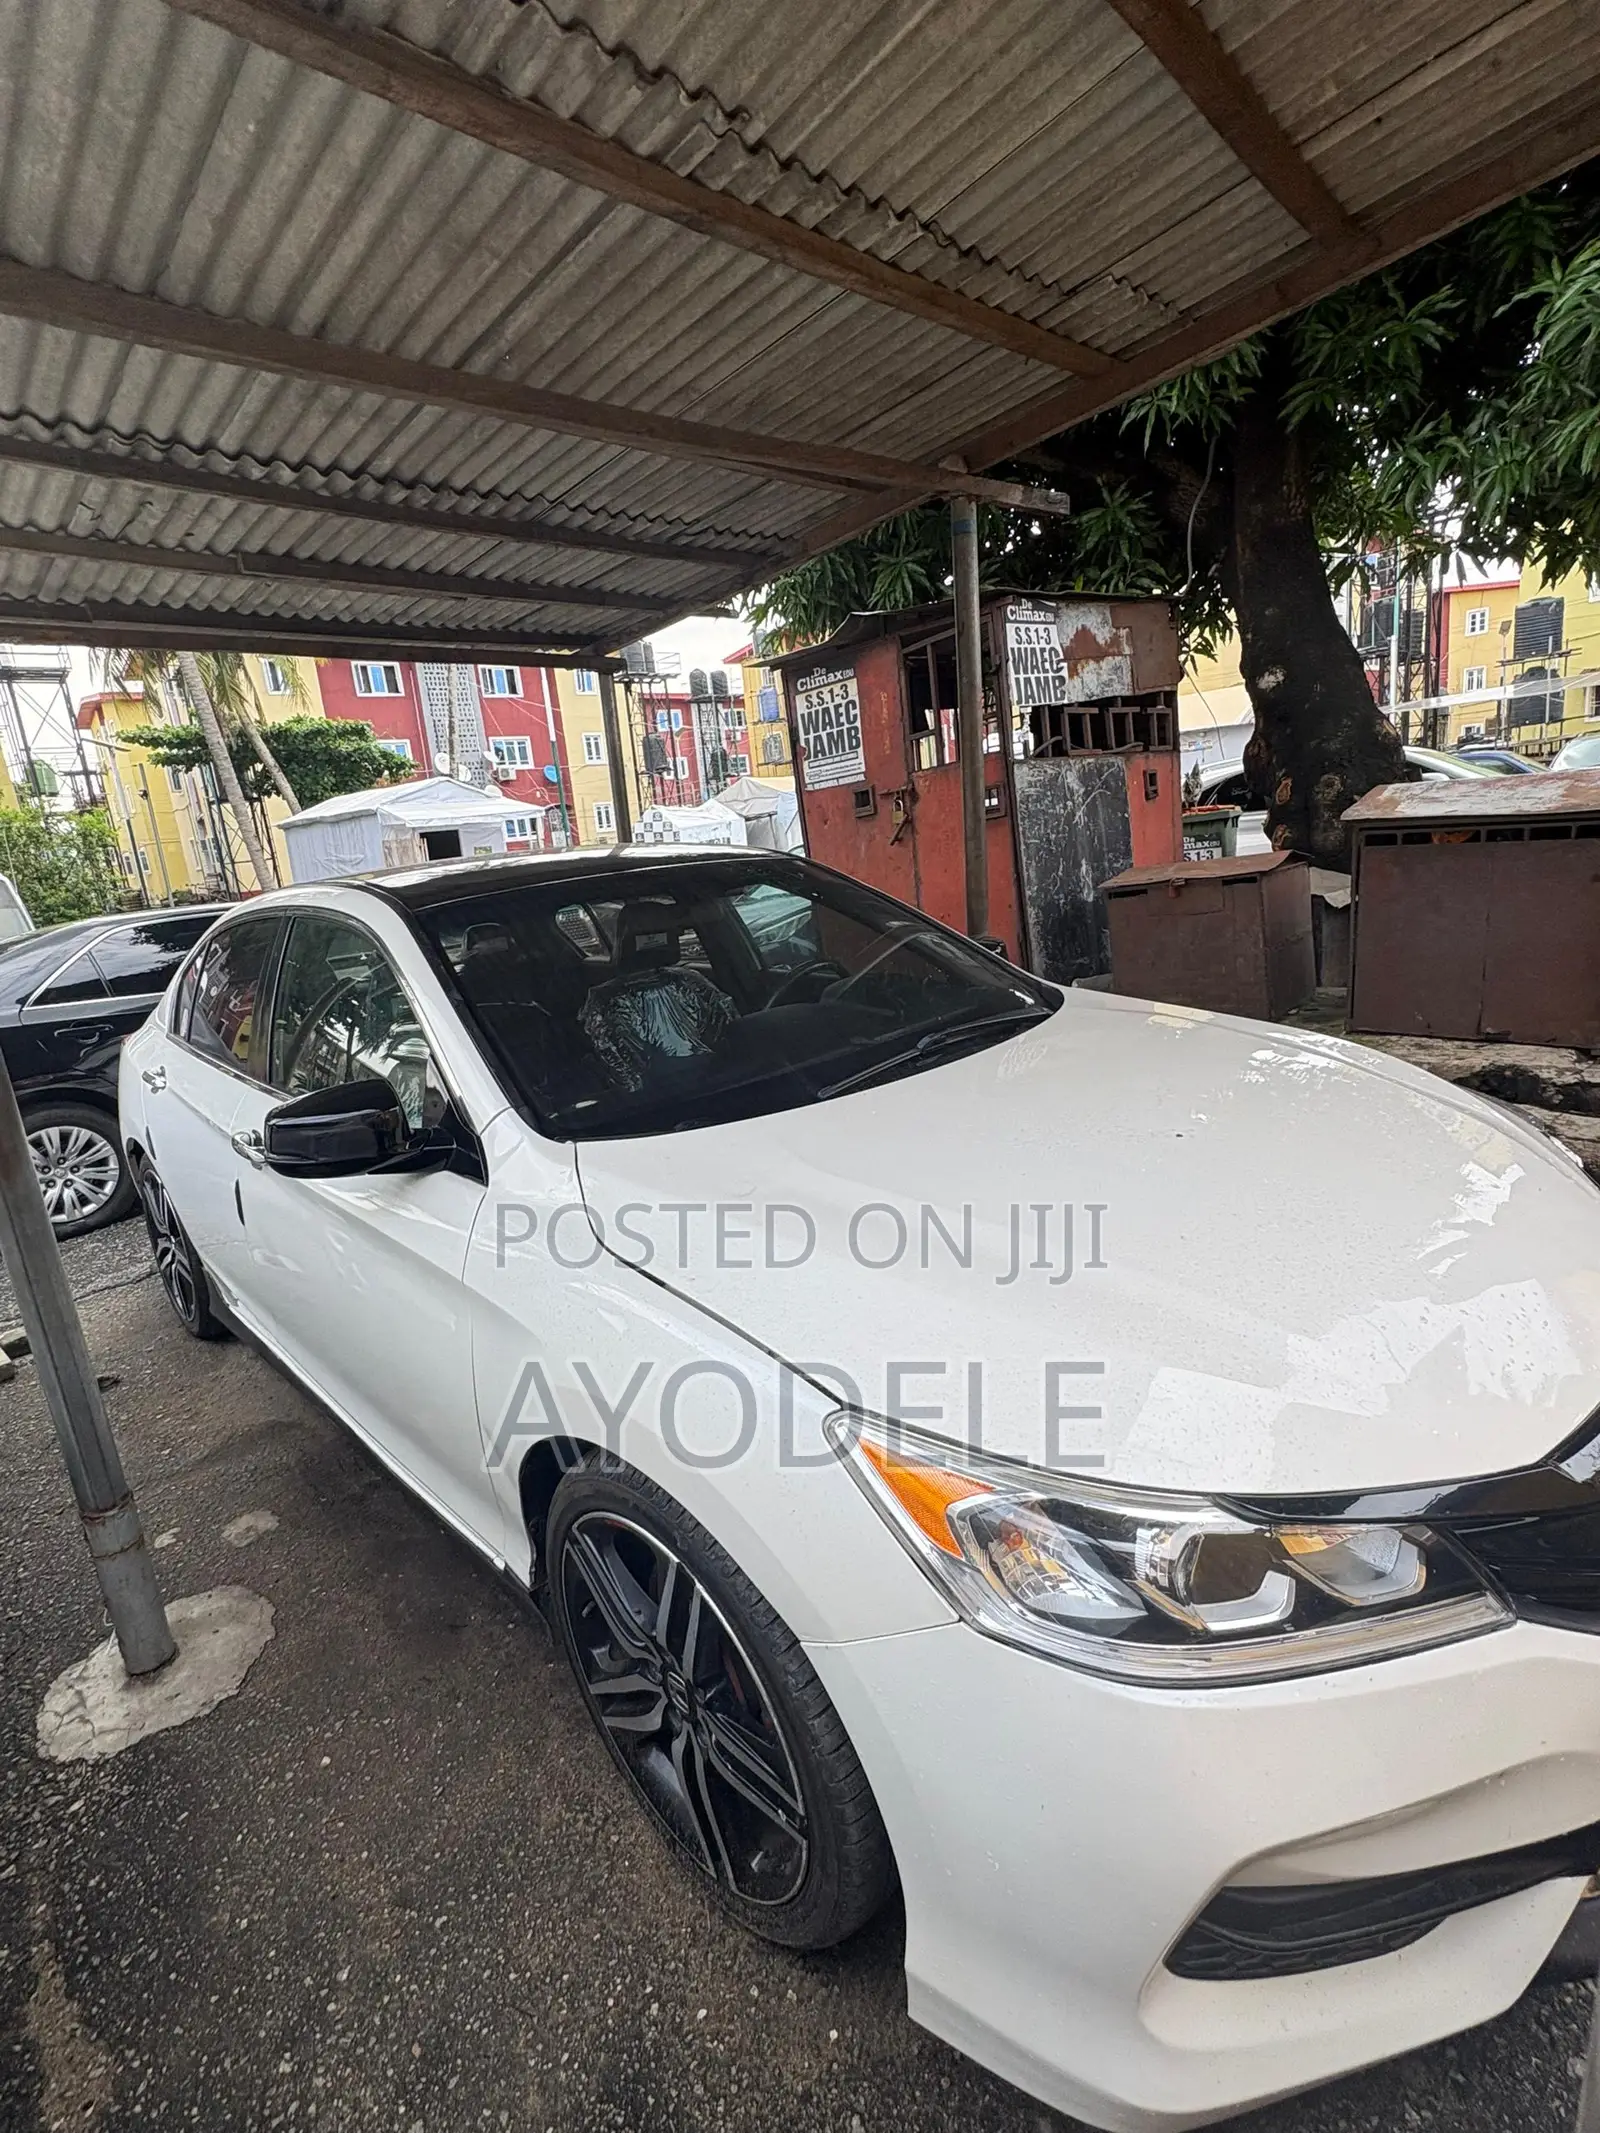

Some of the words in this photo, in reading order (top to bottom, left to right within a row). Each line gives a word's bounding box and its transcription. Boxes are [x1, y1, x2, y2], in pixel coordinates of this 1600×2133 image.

[1006, 605, 1046, 621] Climax
[1021, 598, 1033, 610] De
[1015, 627, 1051, 645] S.S.1-3
[1010, 647, 1066, 675] WAEC
[797, 669, 843, 692] Climax
[813, 667, 827, 676] De
[804, 683, 850, 710] S.S.1-3
[1014, 675, 1066, 705] JAMB
[800, 699, 858, 737] WAEC
[803, 725, 861, 761] JAMB
[1183, 840, 1210, 850] max
[1183, 850, 1214, 862] S.1-3
